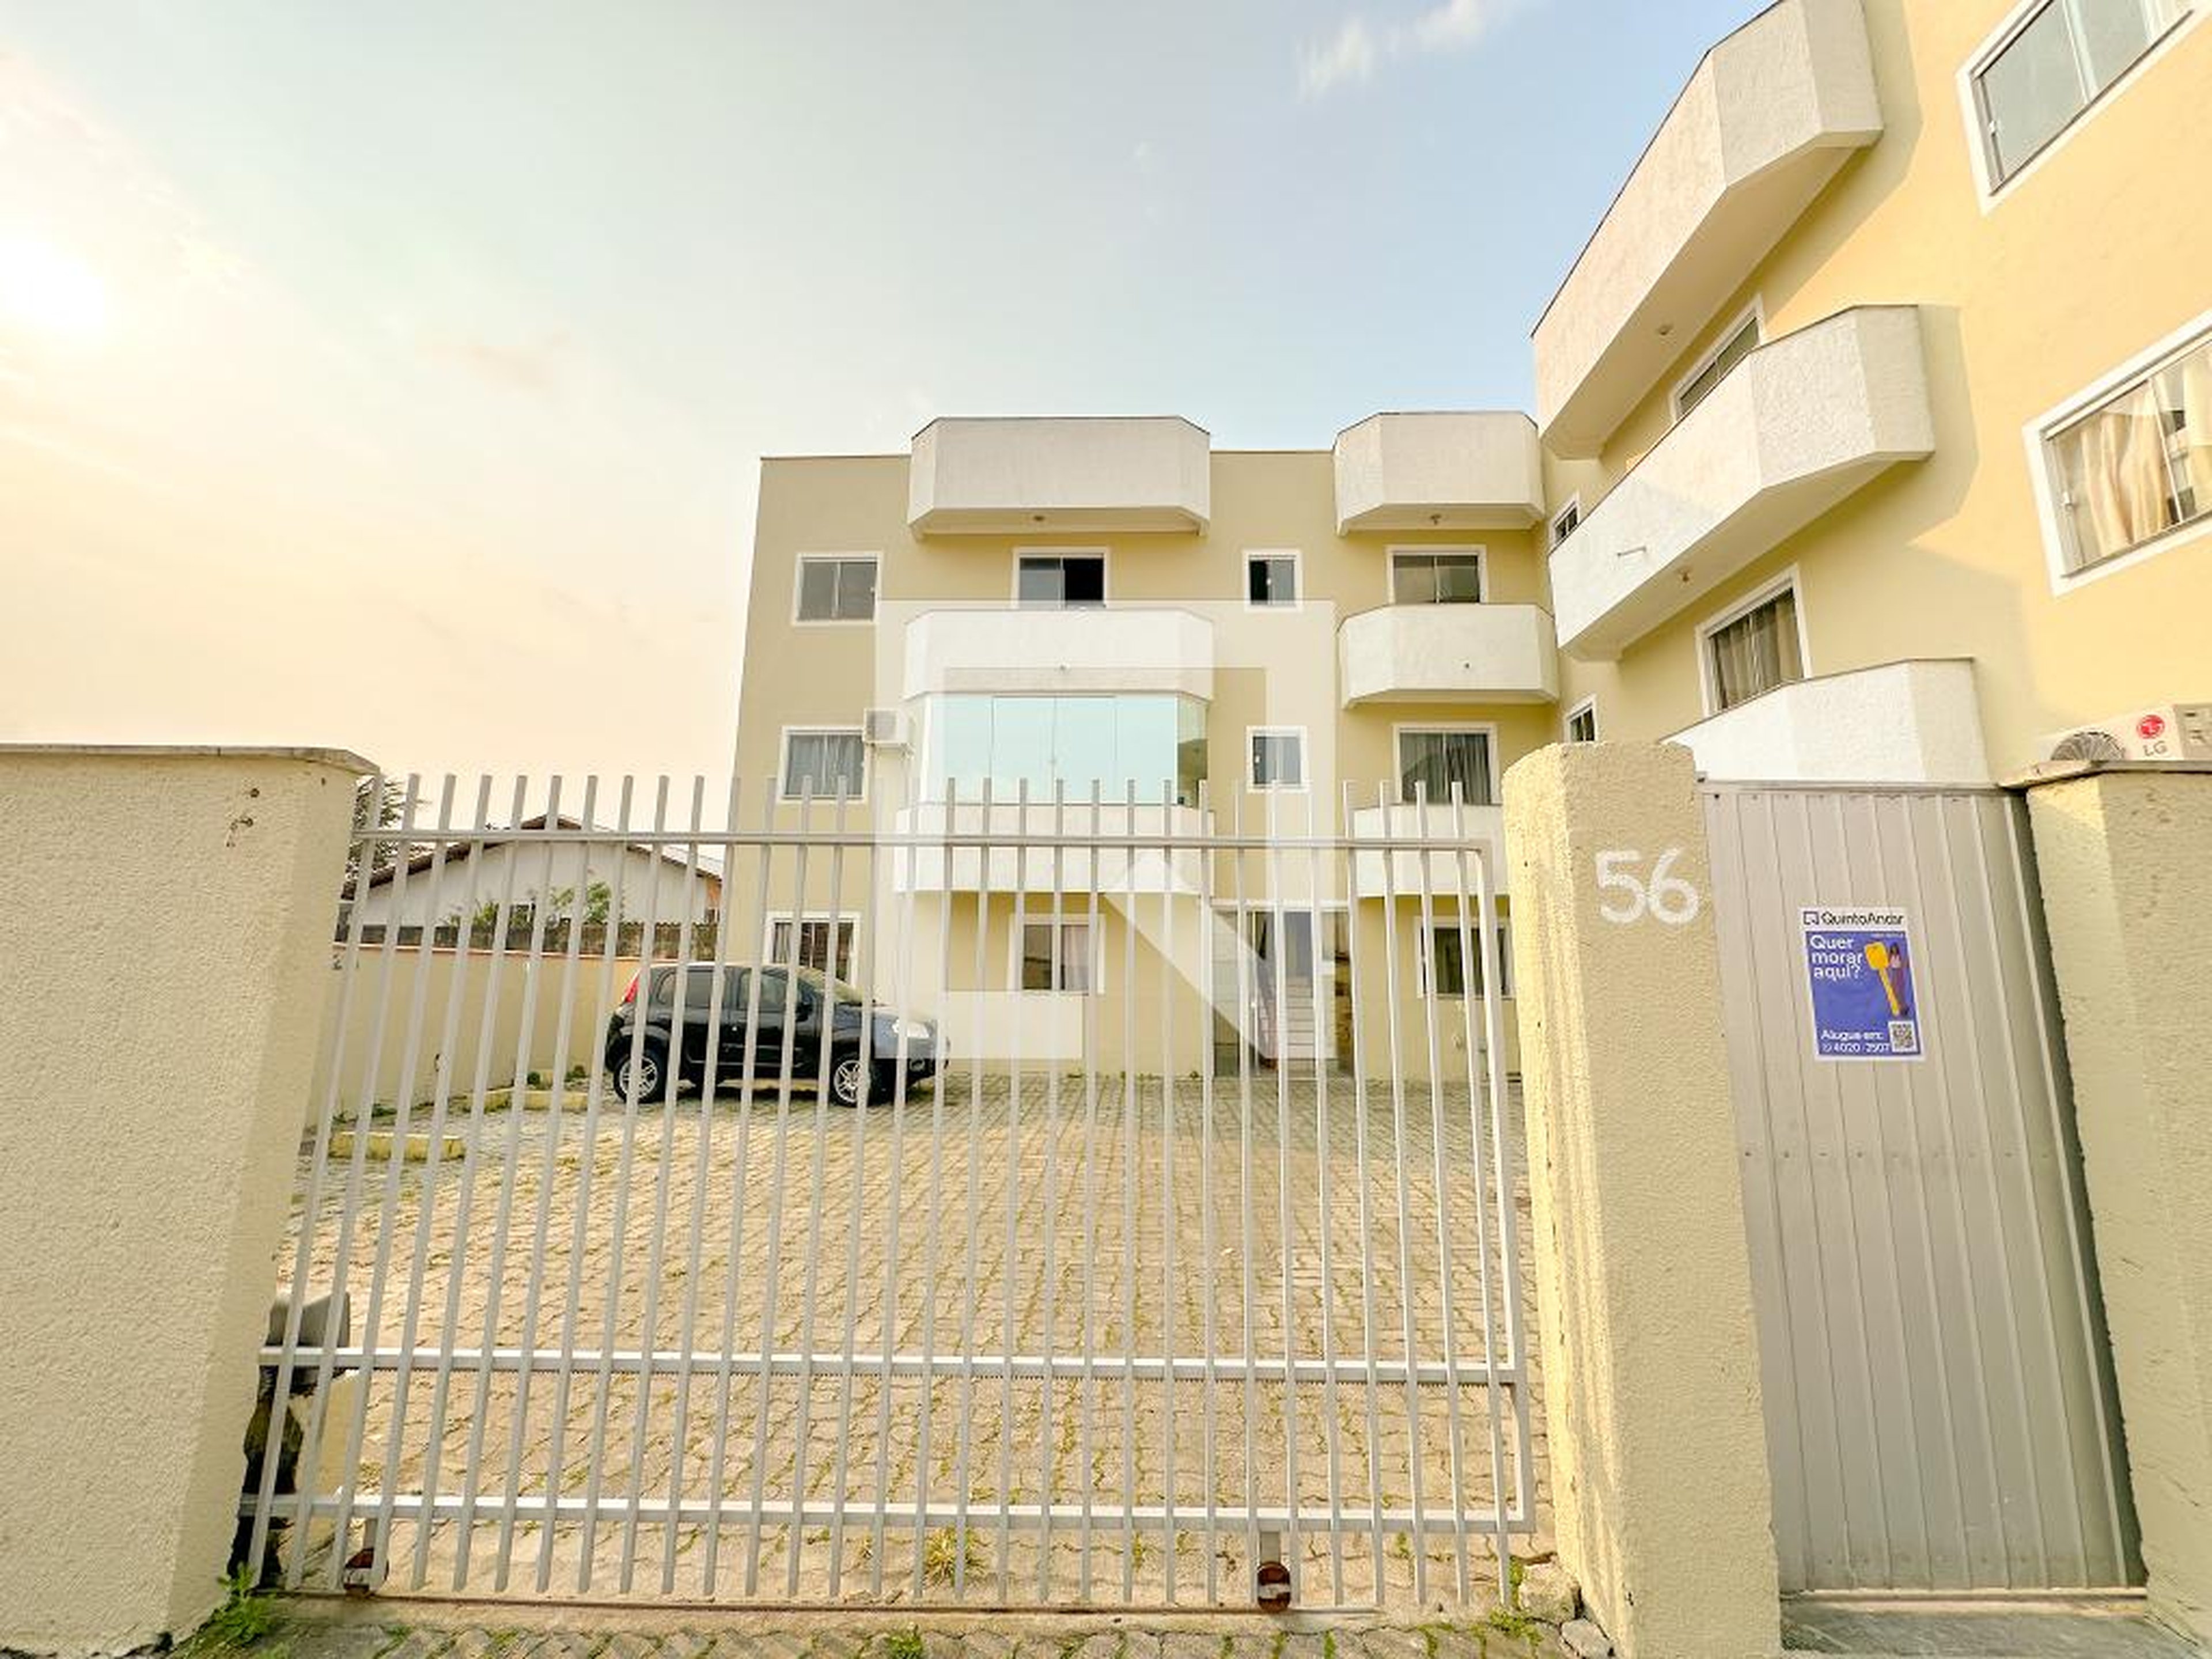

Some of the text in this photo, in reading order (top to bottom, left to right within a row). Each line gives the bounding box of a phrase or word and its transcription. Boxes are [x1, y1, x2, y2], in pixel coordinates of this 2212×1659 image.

[2143, 741, 2168, 756] LG
[1596, 848, 1699, 923] 56
[1821, 911, 1903, 925] QuintoAndar
[1810, 935, 1854, 949] Quer
[1812, 952, 1863, 964] morar
[1814, 965, 1861, 981] aqui?
[1834, 1043, 1861, 1052] 4020
